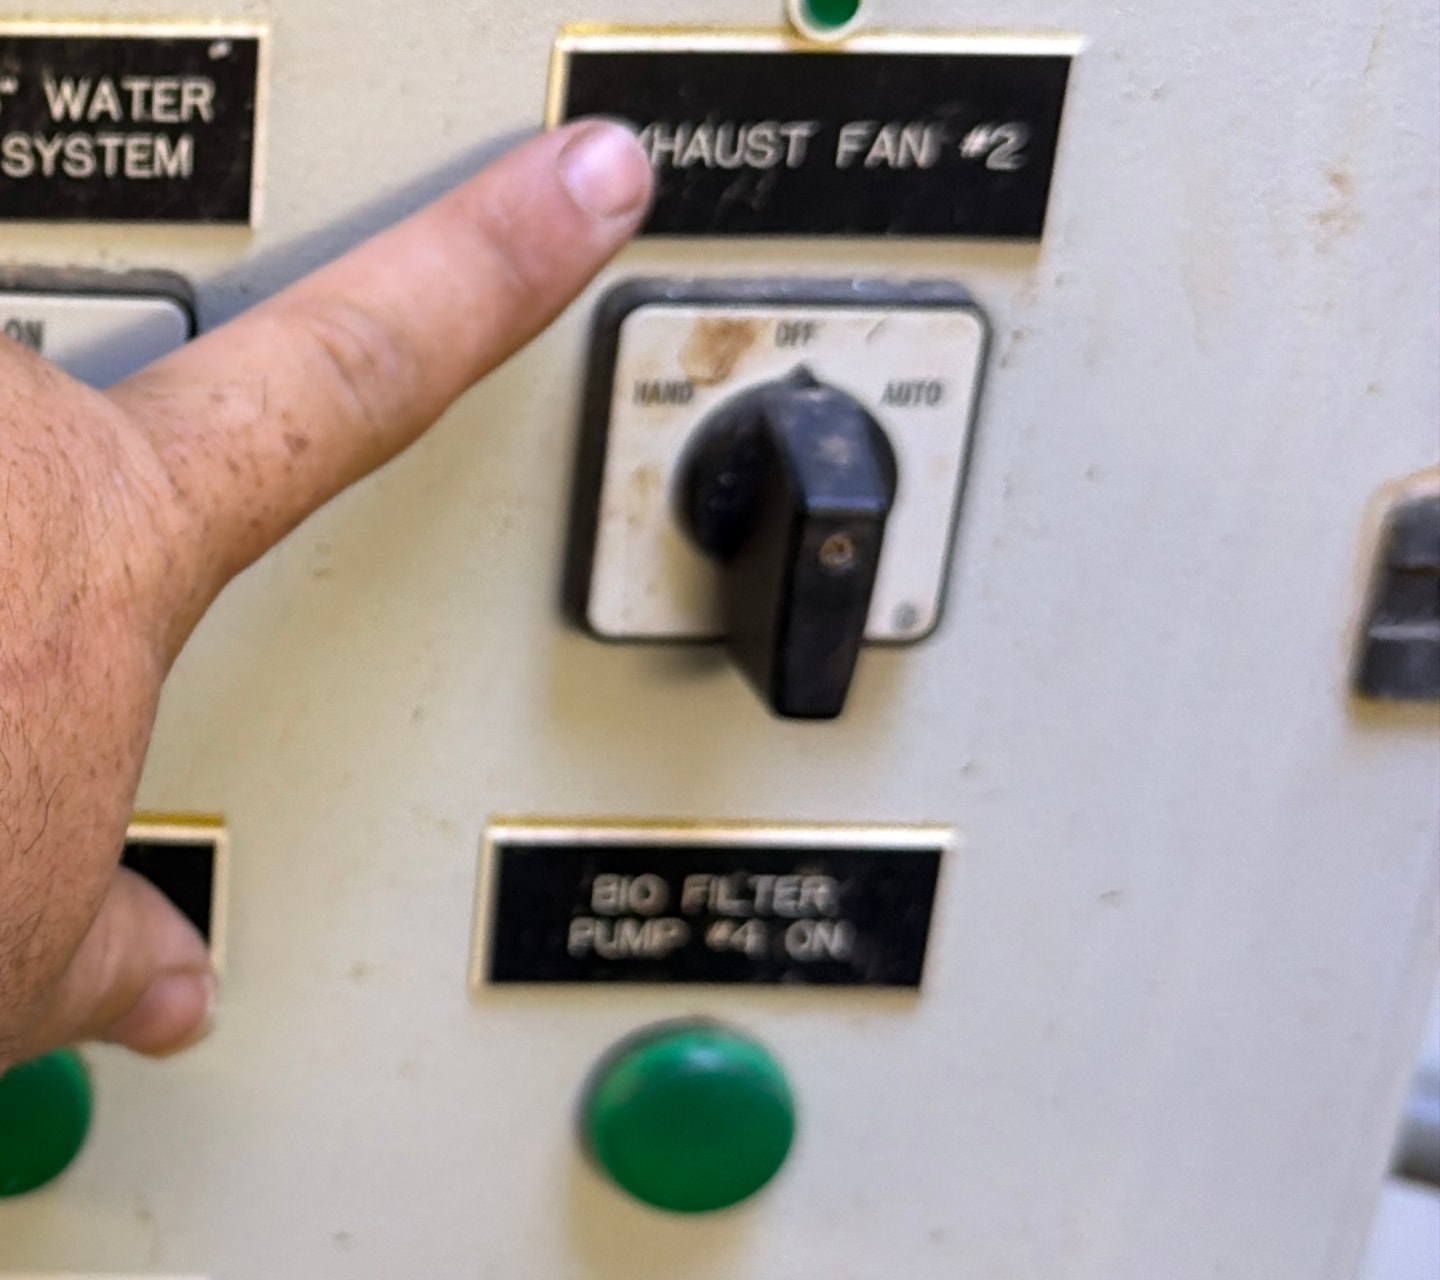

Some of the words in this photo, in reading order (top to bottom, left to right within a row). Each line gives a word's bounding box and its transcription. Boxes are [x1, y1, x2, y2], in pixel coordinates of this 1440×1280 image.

[42, 74, 216, 124] WATER
[0, 131, 196, 180] SYSTEM
[835, 121, 942, 170] FAN
[959, 122, 1032, 172] #2
[775, 322, 816, 349] OFF
[633, 379, 696, 407] HAND
[881, 379, 945, 408] AUTO
[590, 872, 670, 918] BIO
[679, 872, 841, 919] FILTER
[566, 915, 691, 961] PUMP
[784, 919, 857, 962] ON
